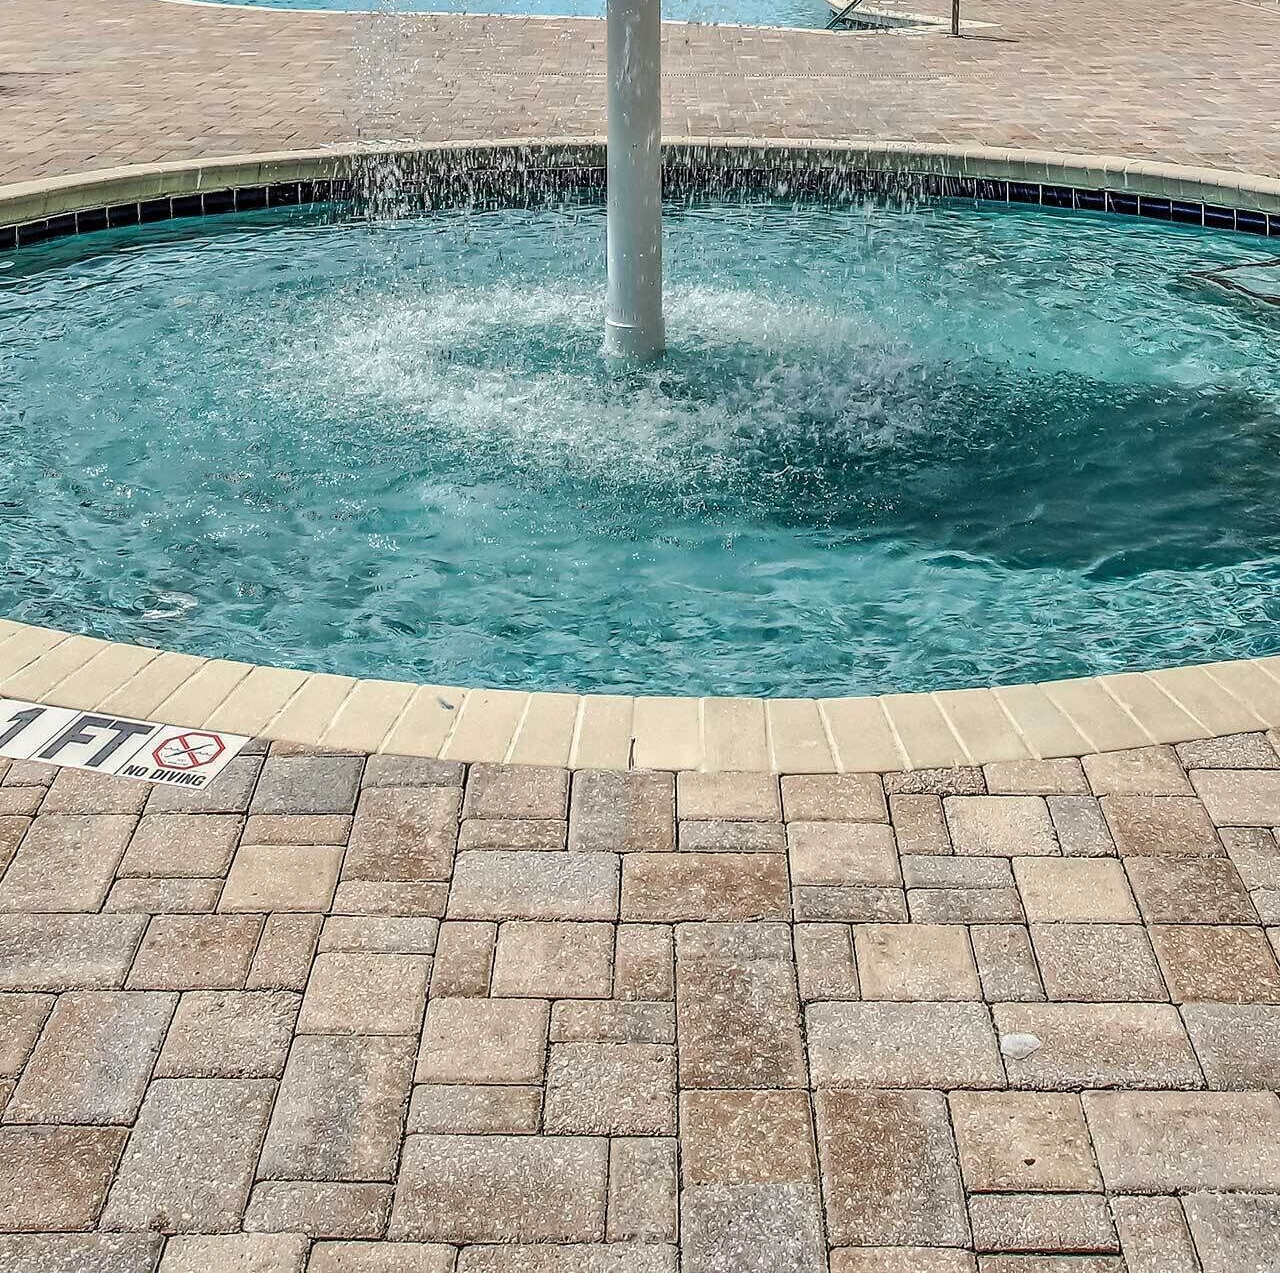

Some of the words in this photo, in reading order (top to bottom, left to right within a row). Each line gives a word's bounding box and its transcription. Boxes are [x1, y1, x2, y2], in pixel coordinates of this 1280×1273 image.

[37, 714, 156, 767] FT
[122, 765, 149, 777] NO
[148, 769, 207, 787] DIVING
